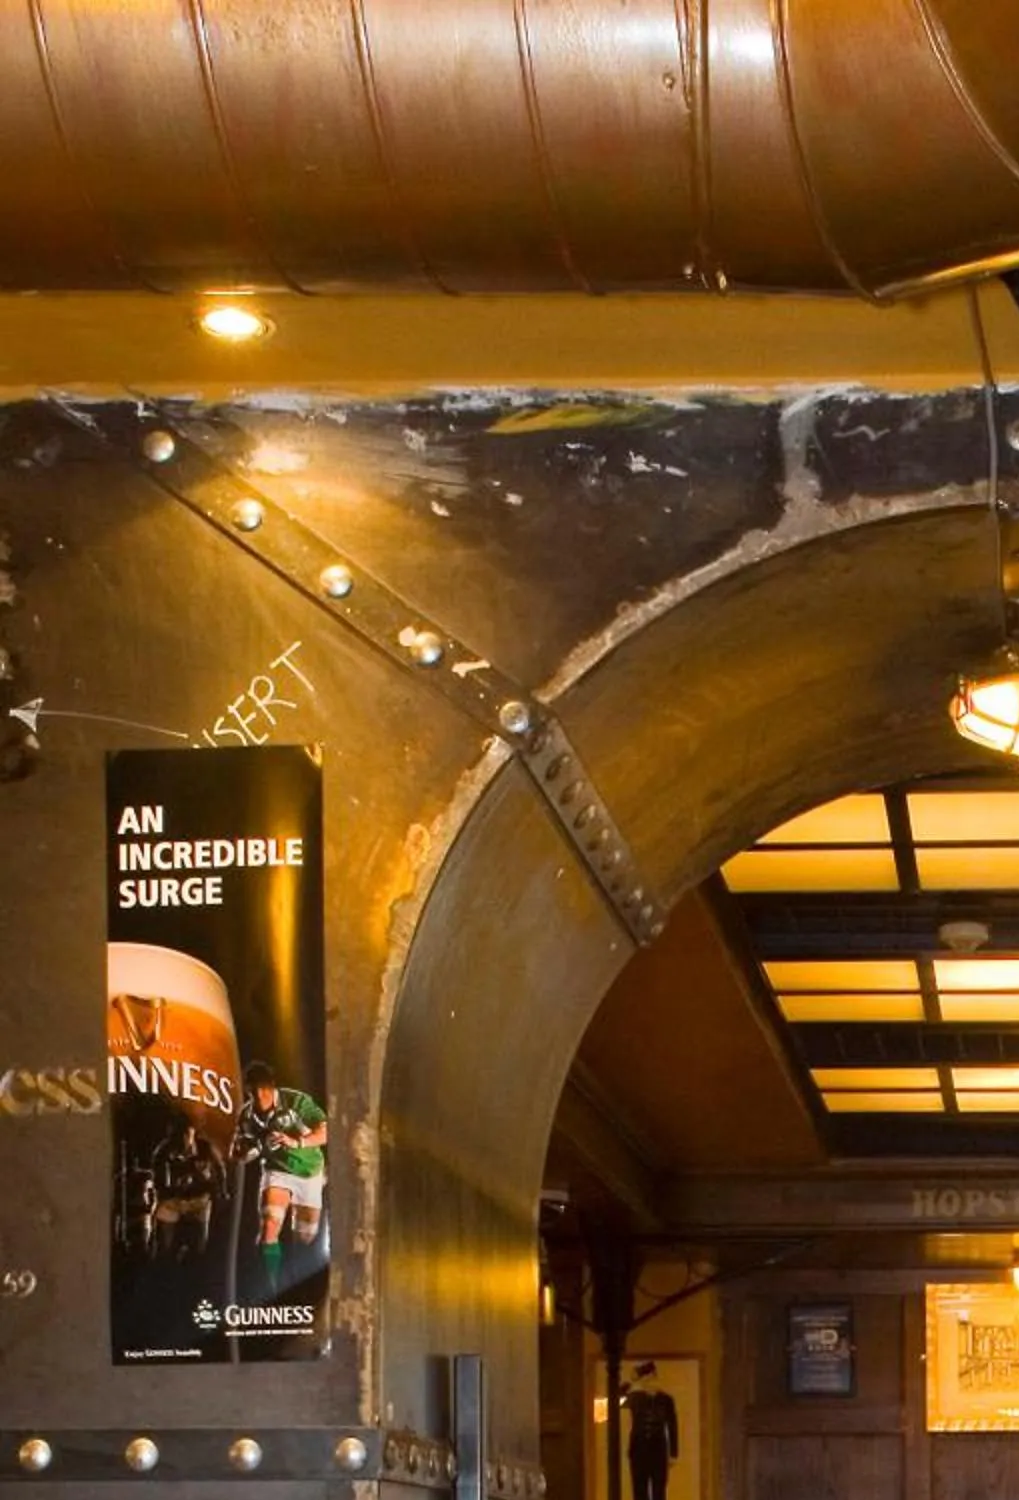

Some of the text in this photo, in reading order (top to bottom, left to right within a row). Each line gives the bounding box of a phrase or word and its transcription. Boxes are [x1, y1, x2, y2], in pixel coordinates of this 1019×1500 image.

[117, 805, 164, 834] AN
[119, 838, 303, 871] INCREDIBLE
[119, 876, 223, 909] SURGE
[225, 1304, 314, 1326] GUINNESS
